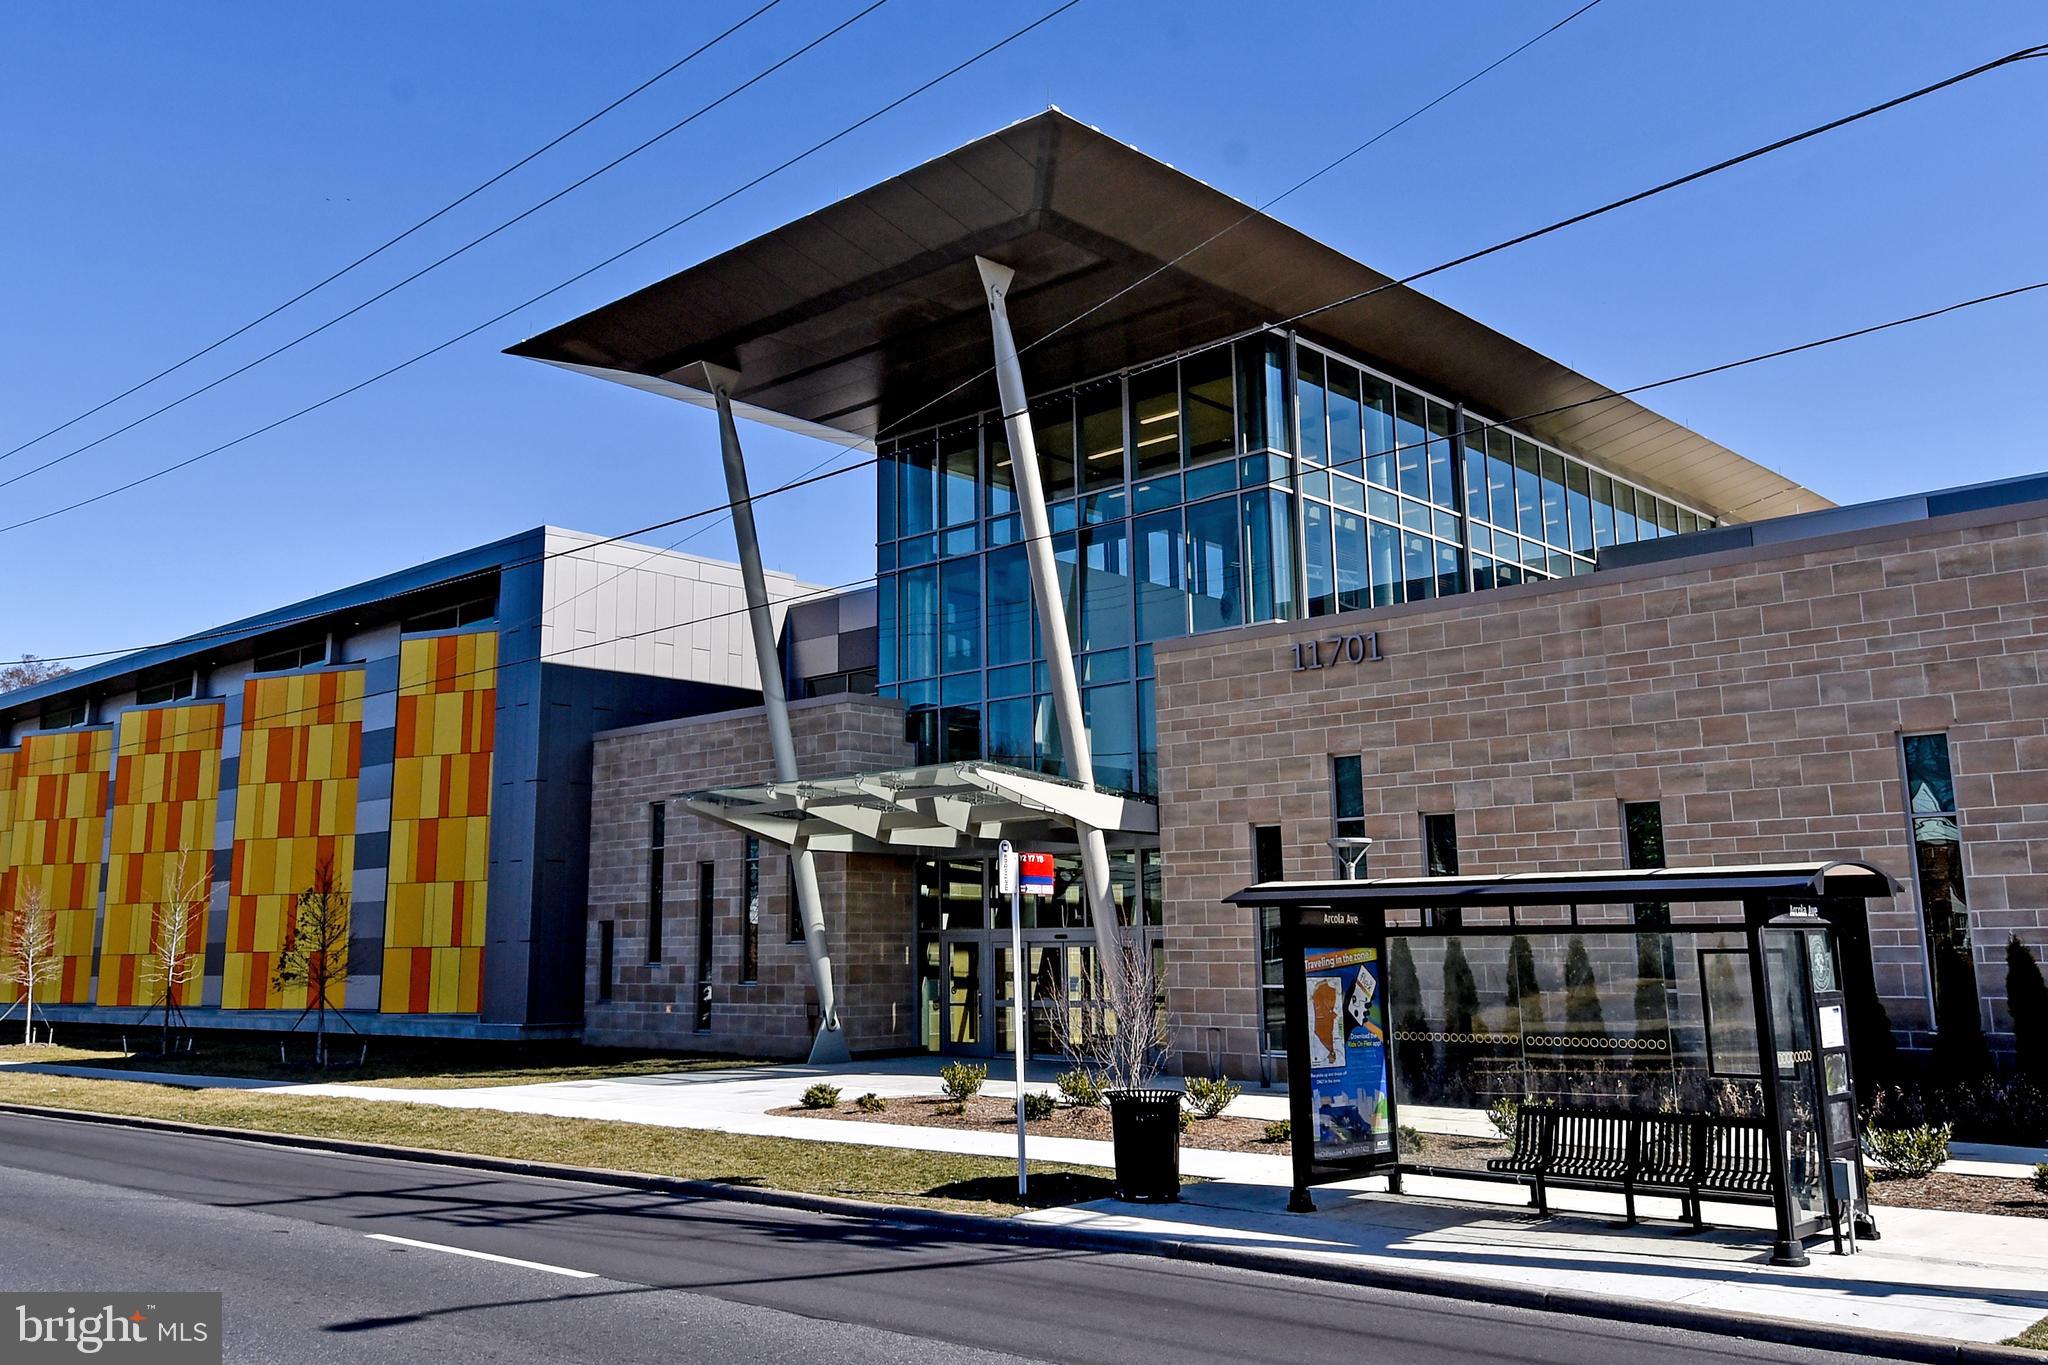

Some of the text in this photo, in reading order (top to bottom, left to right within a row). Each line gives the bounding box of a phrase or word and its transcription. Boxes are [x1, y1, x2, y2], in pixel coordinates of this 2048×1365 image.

[1291, 632, 1383, 671] 11701
[1028, 855, 1035, 863] Y7
[1323, 913, 1359, 924] Arcola Ave
[1304, 956, 1335, 969] Traveling
[1335, 955, 1343, 964] in
[1343, 953, 1353, 962] the
